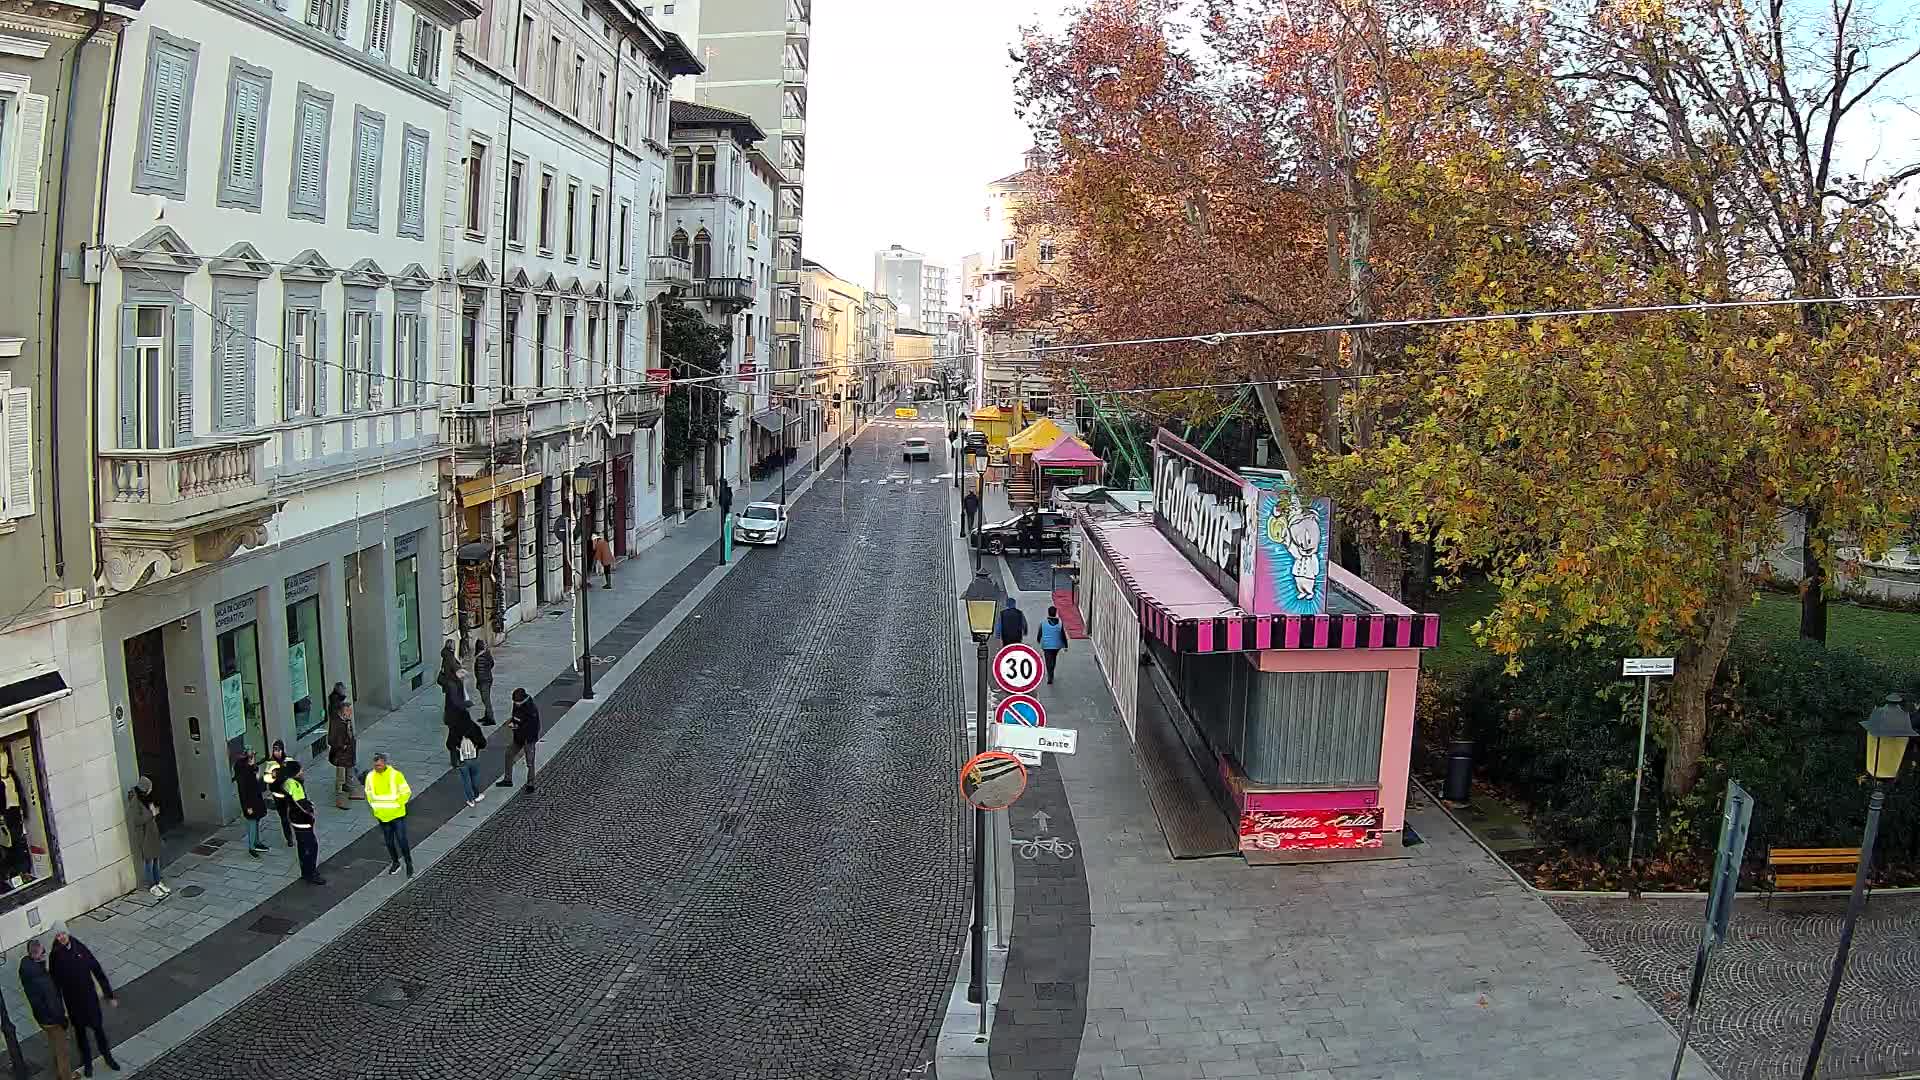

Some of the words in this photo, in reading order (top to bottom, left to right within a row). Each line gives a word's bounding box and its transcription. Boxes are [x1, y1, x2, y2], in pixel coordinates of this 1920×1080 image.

[1163, 459, 1234, 569] Golosone
[1005, 658, 1033, 680] 30
[1038, 737, 1070, 749] Dante
[1323, 814, 1377, 828] Calde
